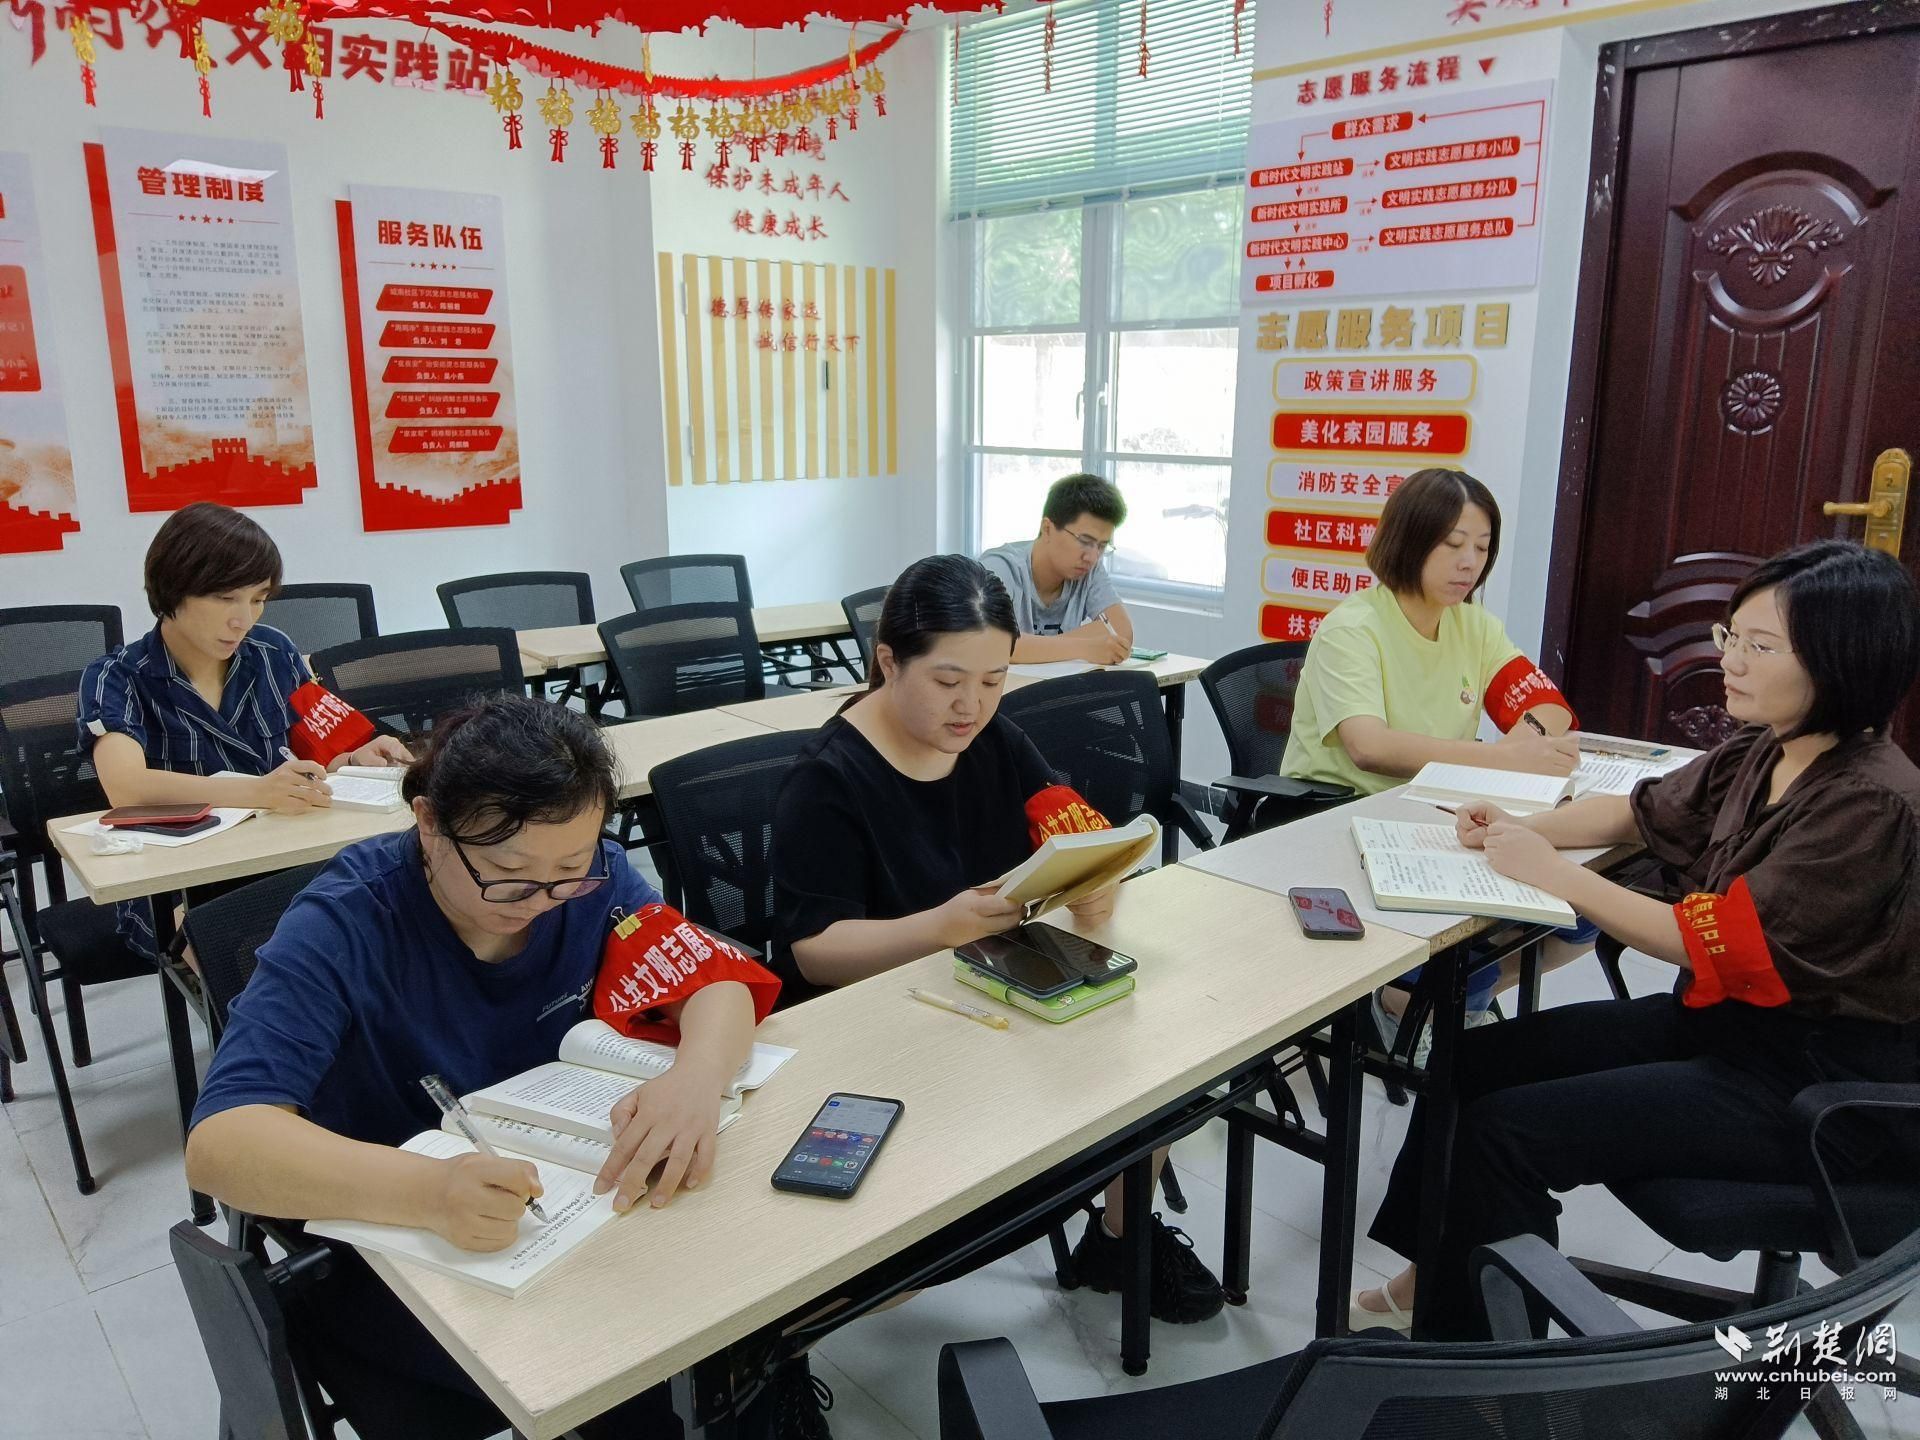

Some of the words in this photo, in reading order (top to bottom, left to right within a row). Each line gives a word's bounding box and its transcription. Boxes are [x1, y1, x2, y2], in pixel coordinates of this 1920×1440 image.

[1298, 56, 1460, 104] 志愿服务流程
[1344, 114, 1400, 138] 群众需求
[1390, 139, 1515, 168] 文明实践志愿服务小队
[138, 166, 264, 202] 管理制度
[705, 163, 850, 202] 保护未成年人
[1259, 161, 1344, 185] 新时代文明实践站
[1387, 179, 1511, 206] 文明实践志愿服务分队
[1257, 198, 1341, 221] 新时代文明实践所
[378, 220, 483, 250] 服务队伍
[731, 209, 828, 241] 健康成长
[1385, 219, 1508, 244] 文明实践志愿服务总队
[1250, 235, 1345, 256] 新时代文明实践中心
[1269, 272, 1320, 290] 项目孵化
[1257, 303, 1510, 350] 志愿服务项目
[1304, 368, 1437, 392] 政策宣讲服务
[1300, 419, 1433, 446] 美化家园服务
